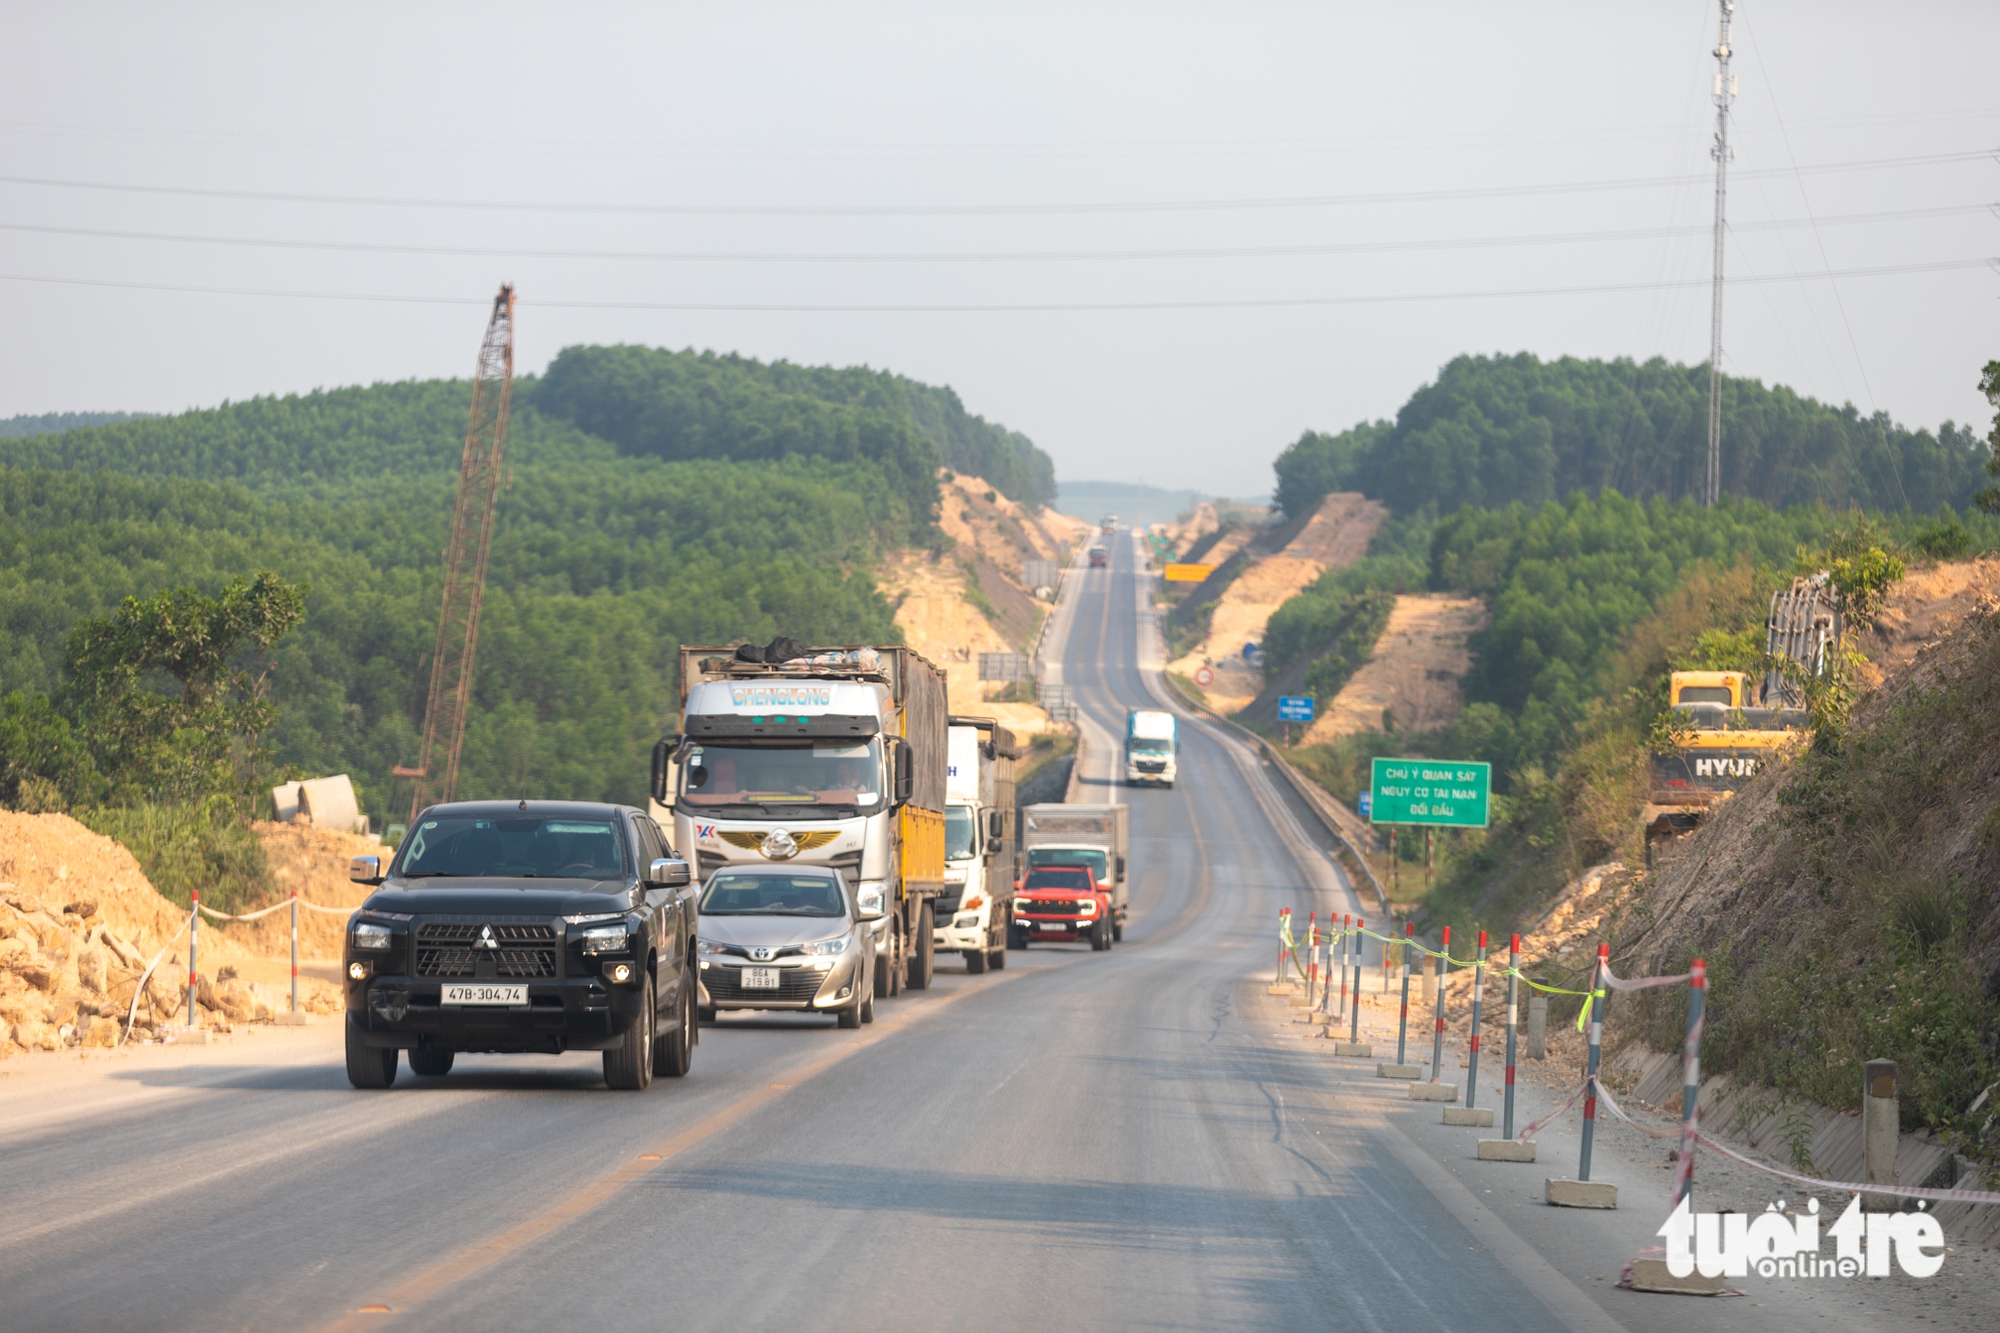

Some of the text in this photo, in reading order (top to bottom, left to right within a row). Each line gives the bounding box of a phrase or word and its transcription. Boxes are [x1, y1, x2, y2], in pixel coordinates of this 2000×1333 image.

[733, 689, 830, 706] CHENGLONG
[1422, 769, 1453, 780] QUAN
[1456, 769, 1476, 782] SÁT
[1381, 785, 1410, 797] NGUY
[1433, 787, 1449, 799] TAI
